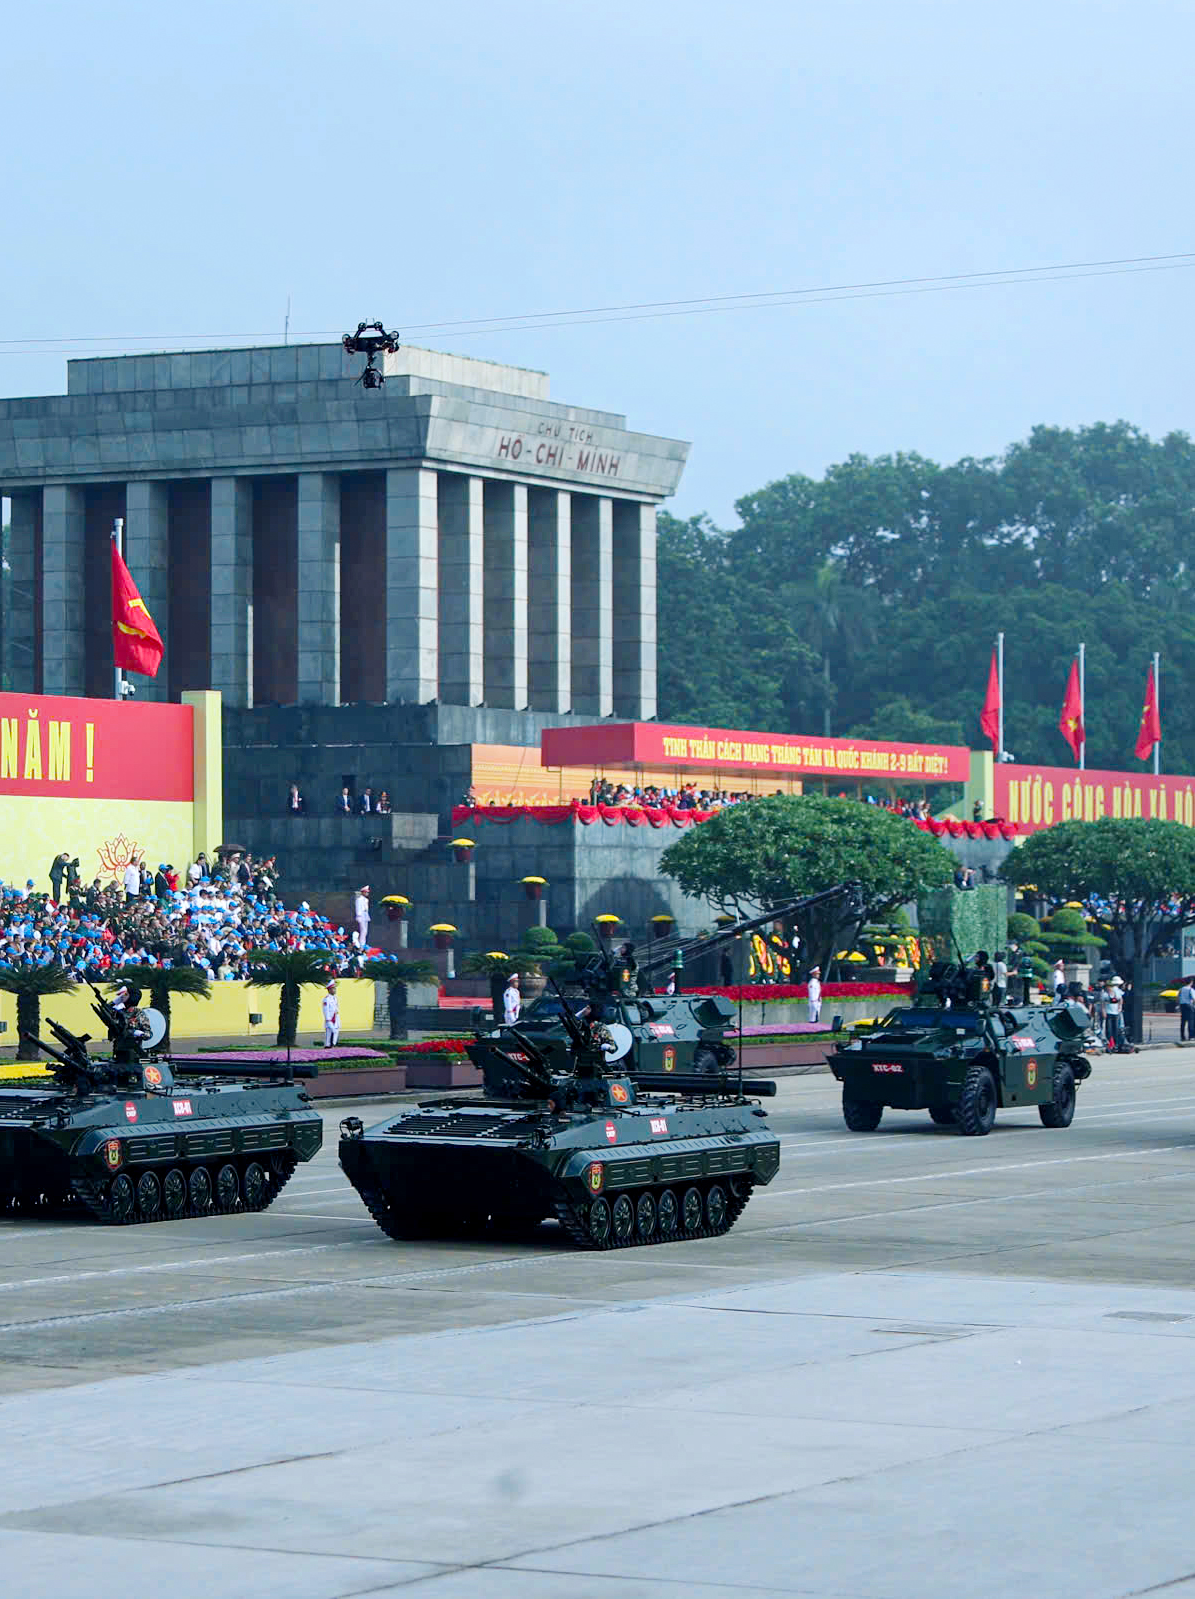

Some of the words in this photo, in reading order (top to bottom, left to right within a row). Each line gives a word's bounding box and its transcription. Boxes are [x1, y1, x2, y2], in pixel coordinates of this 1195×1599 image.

[663, 737, 688, 757] TINH
[689, 733, 716, 759] THẦN
[717, 738, 742, 761] CÁCH
[743, 743, 769, 766] MẠNG
[771, 742, 801, 765] THÁNG
[802, 744, 823, 766] TÁM
[823, 745, 836, 767] VÀ
[837, 745, 859, 769] QUỐC
[860, 748, 889, 771] KHÁNH
[907, 750, 924, 772] BẤT
[1009, 774, 1054, 824] NƯỚC
